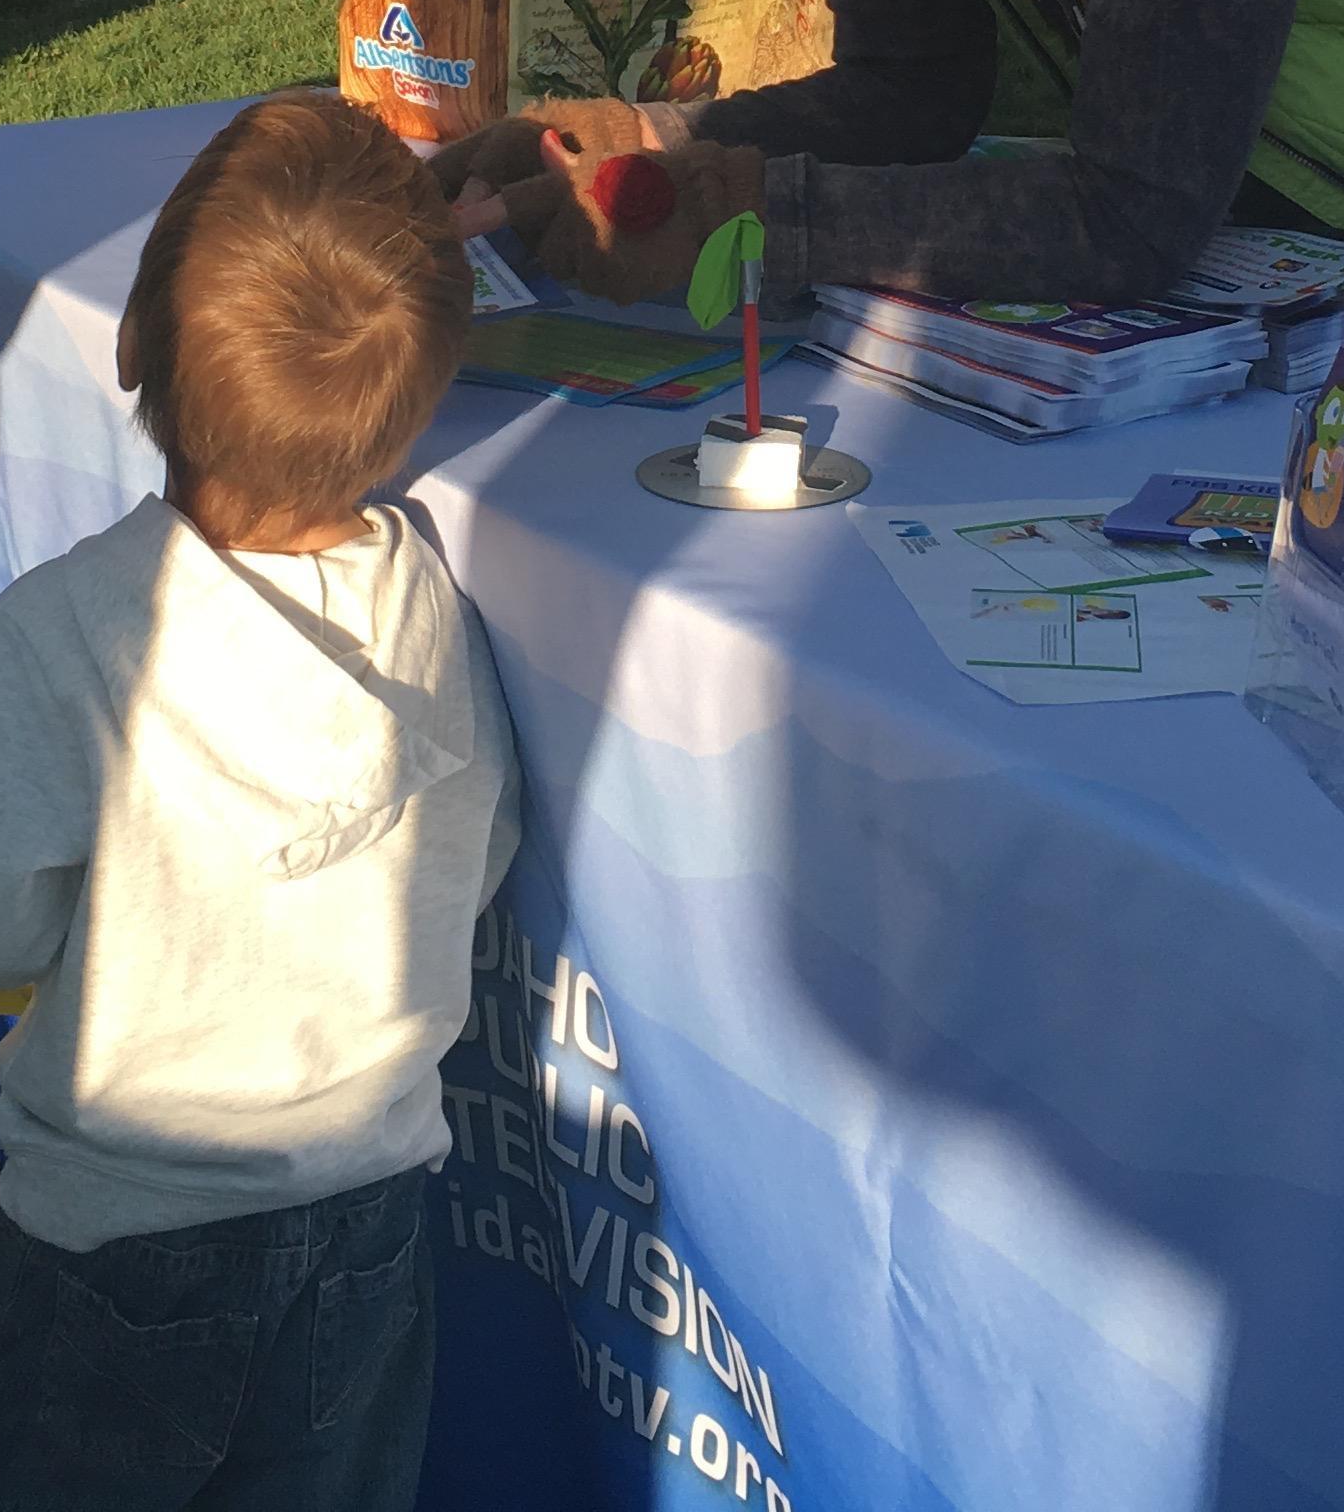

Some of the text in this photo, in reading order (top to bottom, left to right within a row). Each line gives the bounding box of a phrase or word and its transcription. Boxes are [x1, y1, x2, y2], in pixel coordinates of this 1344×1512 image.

[355, 38, 475, 87] Albertsons
[1170, 478, 1229, 491] PBS
[471, 900, 619, 1070] DAHO
